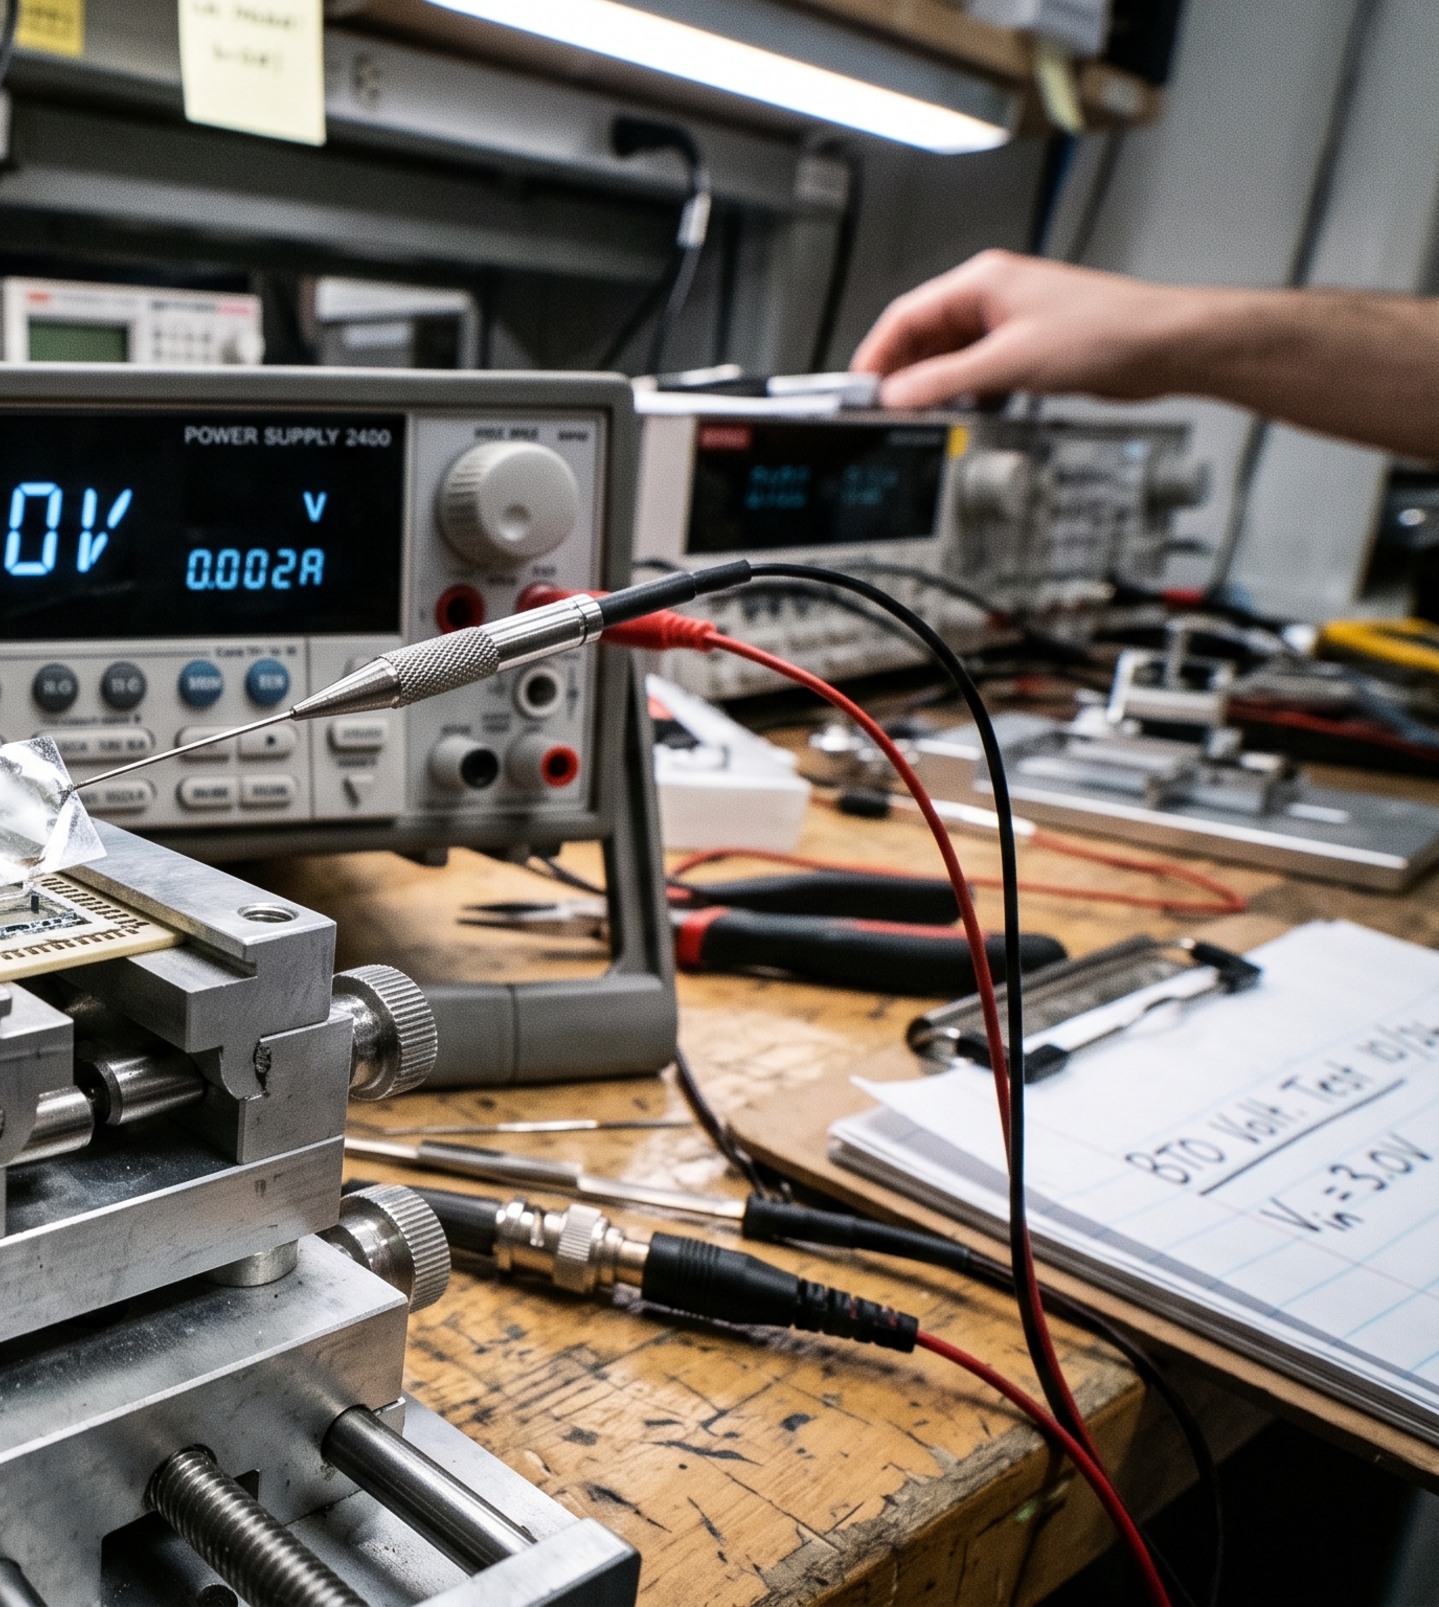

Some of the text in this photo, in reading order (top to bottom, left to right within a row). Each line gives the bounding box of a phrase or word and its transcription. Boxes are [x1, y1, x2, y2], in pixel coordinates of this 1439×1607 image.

[184, 426, 258, 445] POWER
[263, 426, 340, 446] SUPPLY
[186, 548, 325, 590] 0.002A
[1125, 1136, 1226, 1186] BTO
[1279, 1059, 1374, 1106] Test
